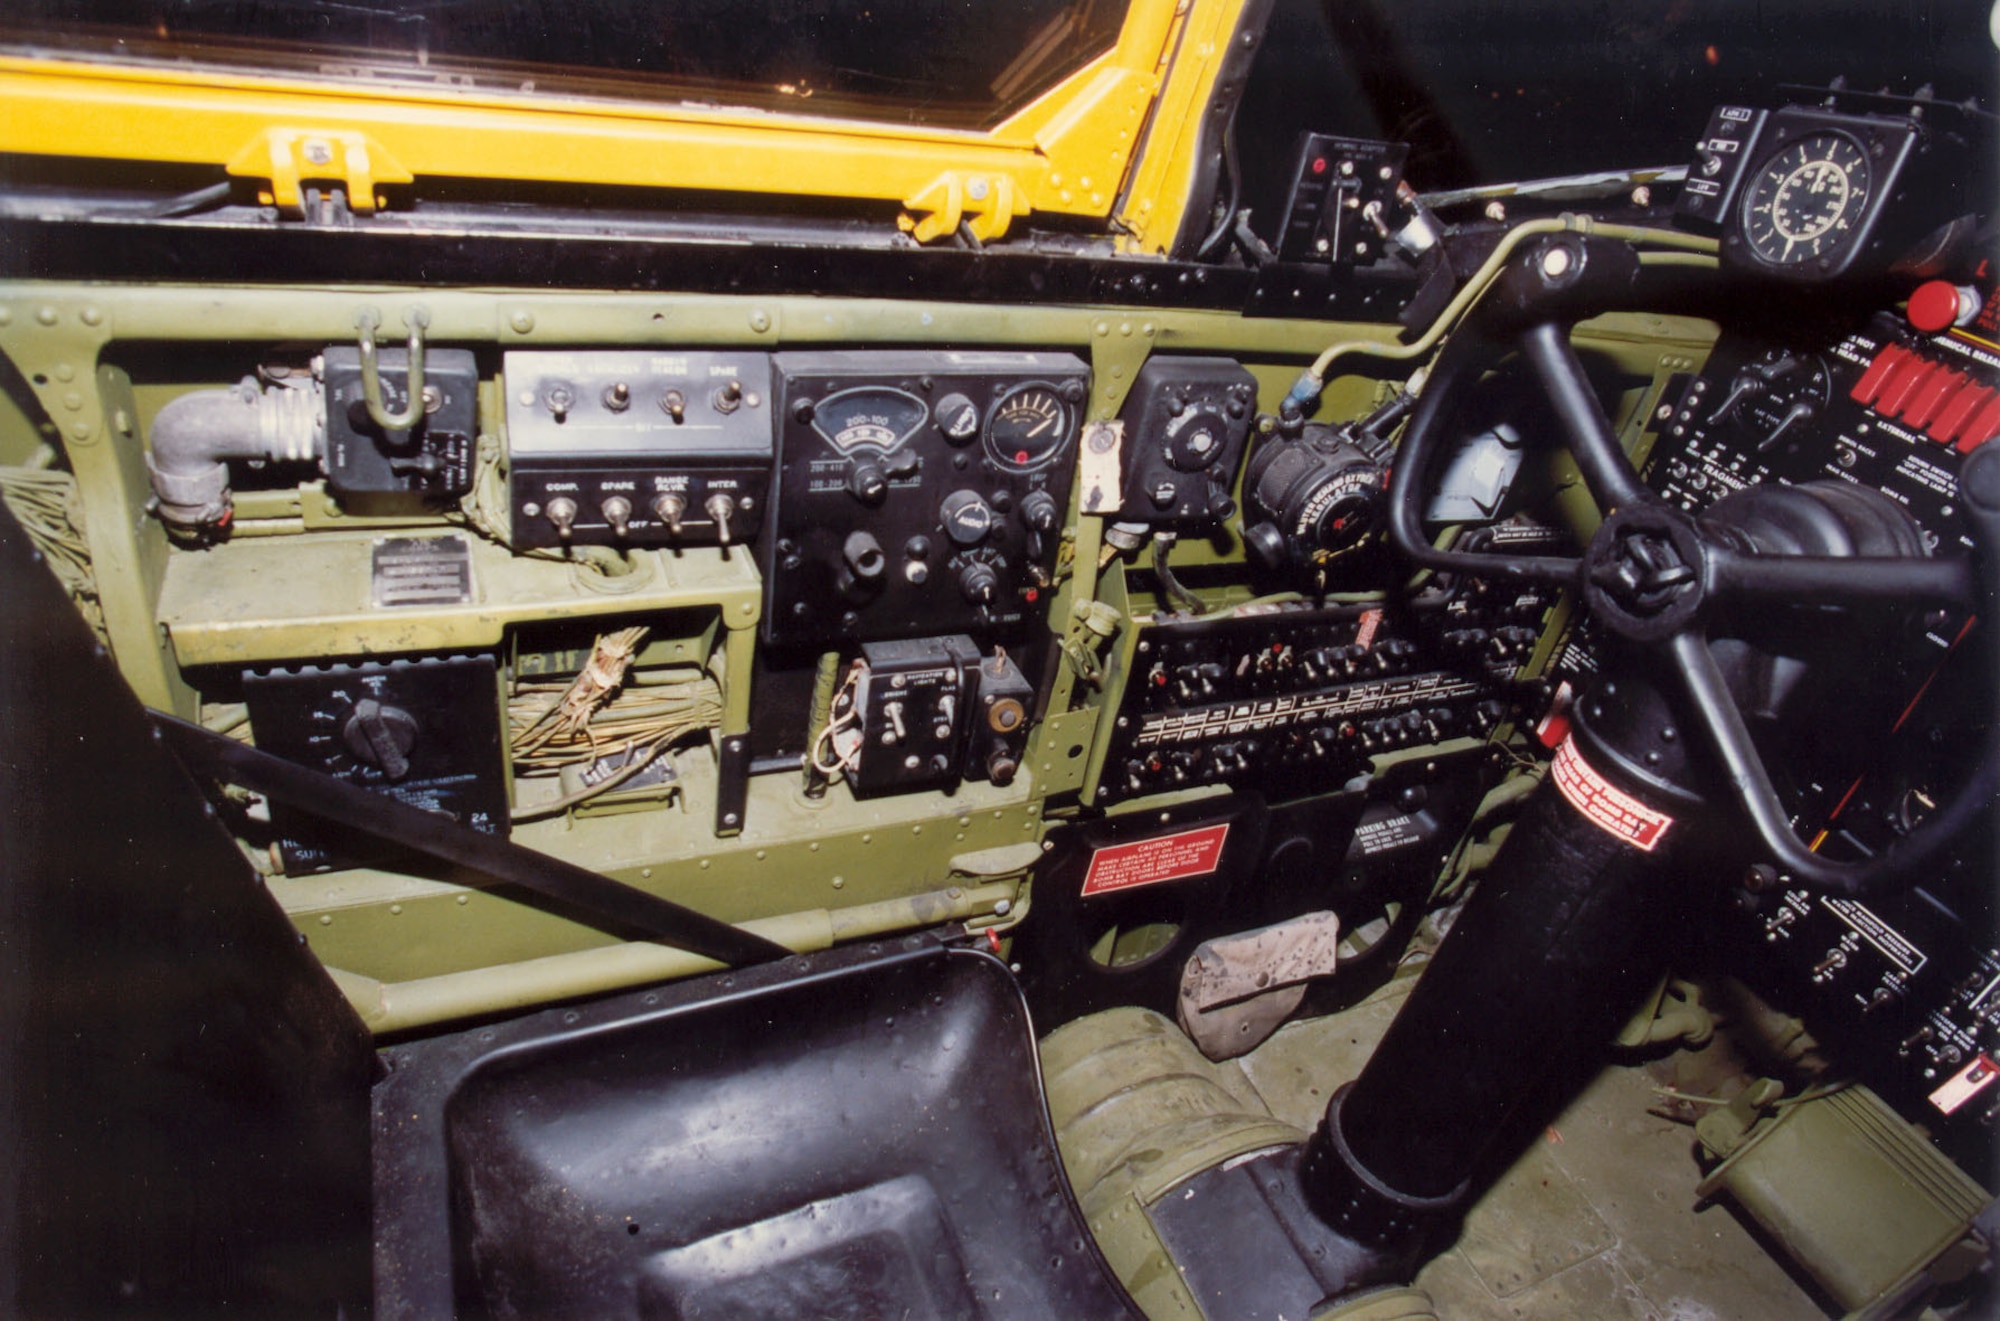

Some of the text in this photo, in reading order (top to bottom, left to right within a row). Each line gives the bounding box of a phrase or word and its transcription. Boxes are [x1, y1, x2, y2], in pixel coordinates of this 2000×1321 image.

[1845, 162, 1853, 173] 6
[1850, 187, 1859, 199] 7
[1856, 335, 1877, 350] NOT
[1837, 348, 1859, 362] HEAD
[709, 366, 738, 377] SPARE
[1813, 372, 1822, 383] R
[1876, 420, 1917, 444] EXTERNAL
[1858, 443, 1876, 458] RACKS
[1825, 463, 1858, 484] FRAG RACKS
[1907, 454, 1954, 480] RETURN SWITCH
[654, 476, 689, 485] RANGE
[1895, 465, 1929, 485] INDICATING
[1929, 483, 1948, 494] LAMP
[1919, 468, 1947, 486] POSITION
[601, 481, 636, 490] SPARE
[628, 520, 649, 529] OFF
[958, 516, 984, 528] AUDIO
[1926, 631, 1949, 648] CLOSED
[332, 690, 346, 698] 20
[1565, 781, 1589, 806] WHEN
[1579, 783, 1592, 796] OF
[1591, 793, 1624, 817] BOMB
[1622, 812, 1647, 830] BAY
[472, 812, 489, 823] 24
[1354, 815, 1410, 836] PARKING BRAKE
[1099, 857, 1120, 866] WHEN
[1121, 852, 1152, 863] AIRPLANE
[1187, 838, 1215, 849] GROUND
[1138, 840, 1174, 853] CAUTION
[1097, 864, 1117, 872] MAKE
[1118, 859, 1145, 868] CERTAIN
[1158, 849, 1193, 860] PERSONNEL
[1093, 875, 1113, 883] BOMB
[1156, 862, 1180, 872] BEFORE
[1180, 858, 1199, 867] DOOR
[1096, 864, 1140, 877] OBSTRUCTION
[1142, 861, 1155, 869] ARE
[1097, 878, 1129, 888] CONTROL
[1138, 869, 1170, 880] OPERATED
[1850, 913, 1878, 937] INJECTION
[1877, 935, 1913, 965] INOPERATIVE
[1856, 910, 1885, 934] MANIFOLD
[1884, 932, 1911, 955] PRESSURE
[1938, 1031, 1949, 1041] ON
[1953, 1034, 1971, 1051] WING
[1957, 1030, 1976, 1045] PUMP
